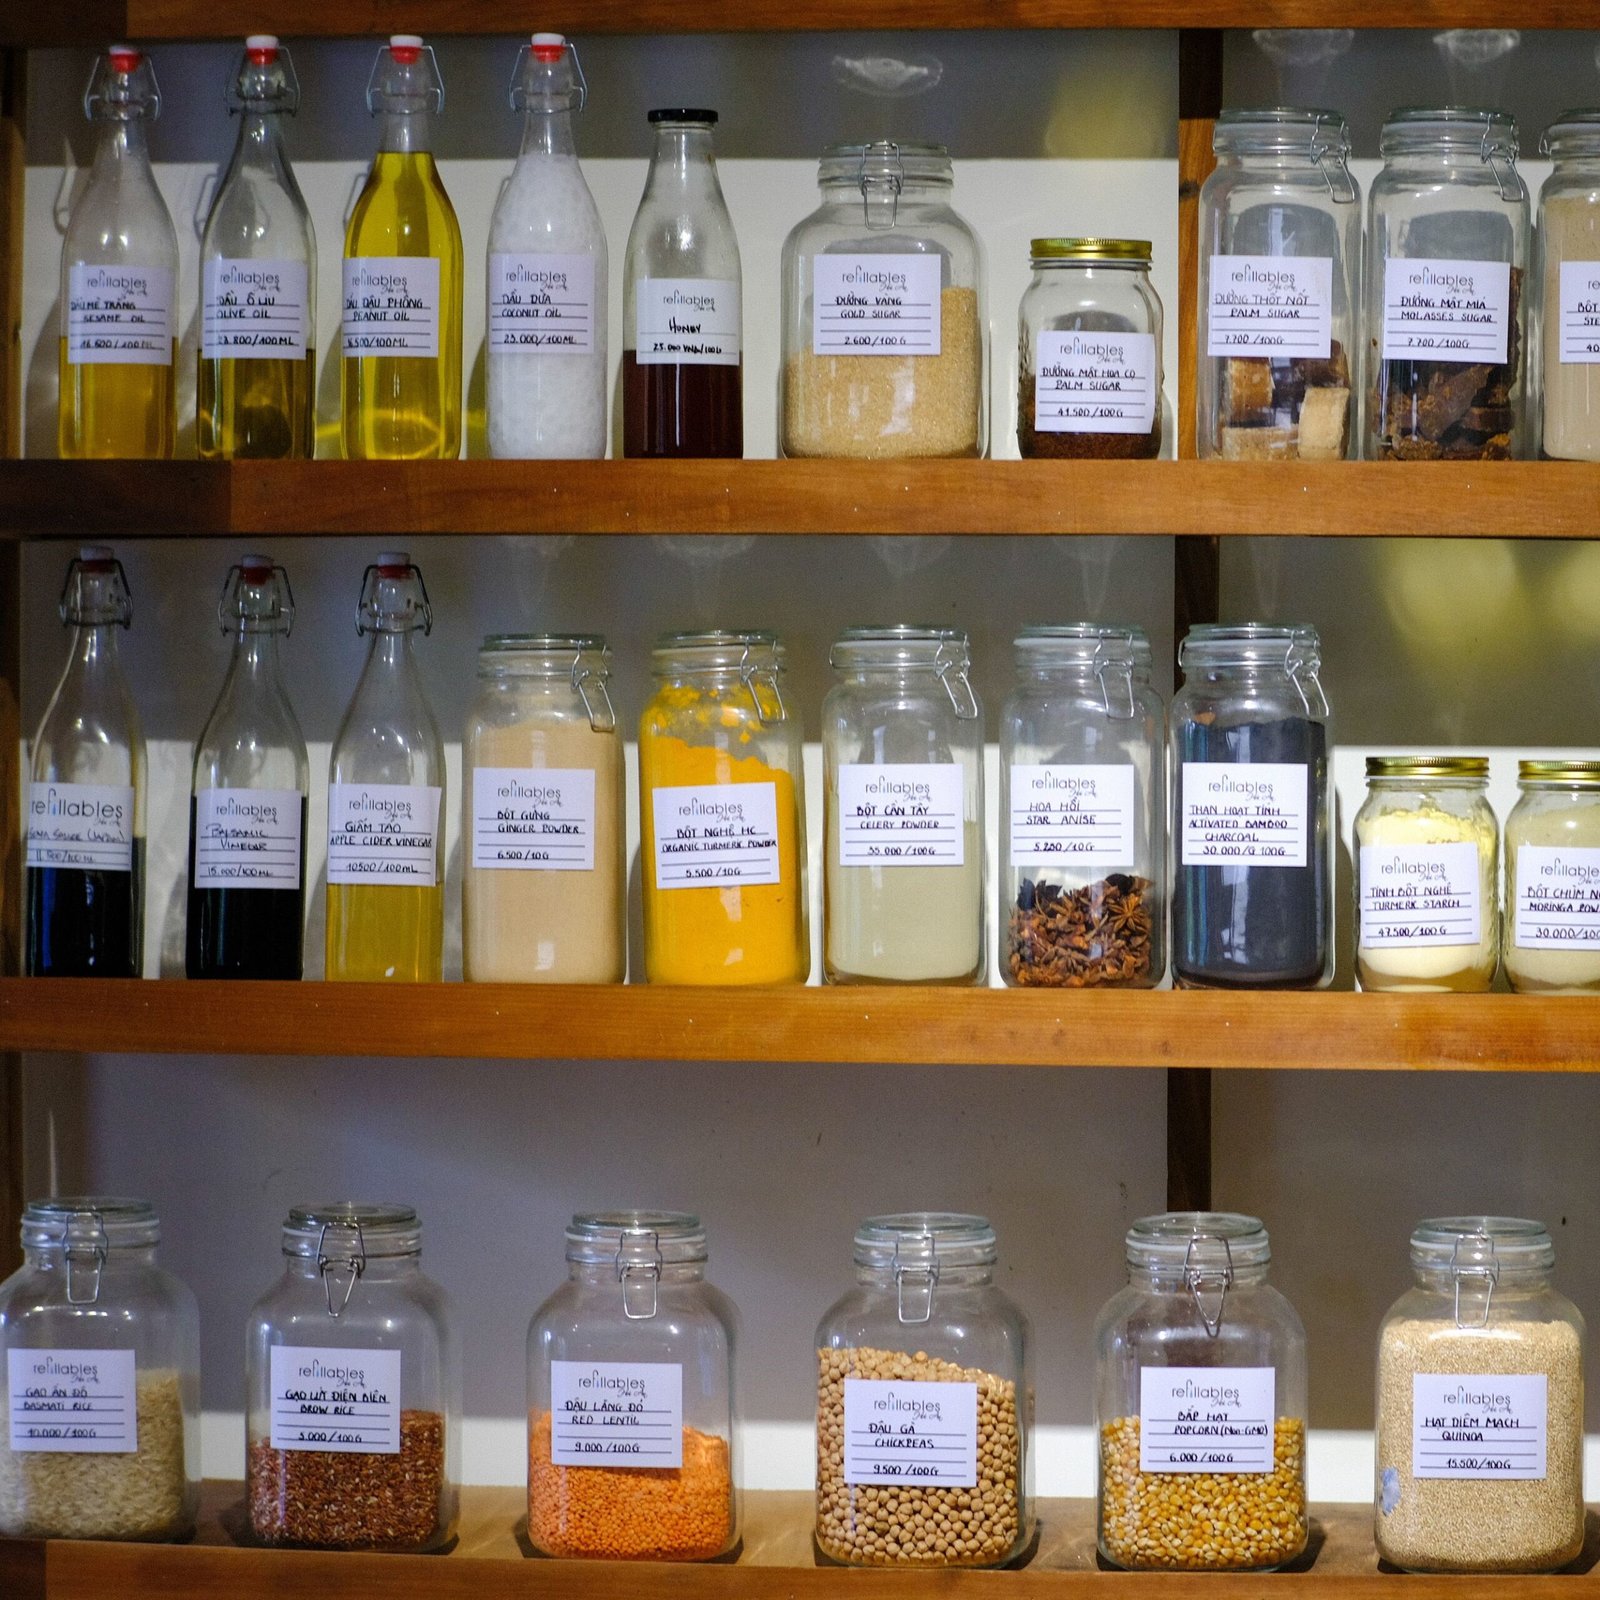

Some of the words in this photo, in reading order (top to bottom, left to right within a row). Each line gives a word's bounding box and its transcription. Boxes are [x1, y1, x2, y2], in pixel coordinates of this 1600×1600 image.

[87, 270, 147, 288] refillables
[220, 265, 279, 283] refillables
[352, 268, 407, 286] refillables
[506, 264, 566, 282] refillables
[842, 265, 906, 284] refillables
[1232, 264, 1295, 282] refillables
[1410, 267, 1473, 286] refillables
[663, 289, 715, 304] refillables
[131, 314, 145, 323] OIL
[253, 307, 271, 318] OIL
[353, 311, 388, 321] PEANUT
[394, 311, 409, 321] OIL
[502, 308, 539, 317] COCONUT
[545, 307, 561, 317] OIL
[841, 309, 865, 319] GOLD
[872, 309, 901, 319] SUGAR
[1230, 308, 1260, 318] PALM
[1268, 308, 1300, 318] SUGAR
[1401, 311, 1454, 321] MOLASSES
[1462, 313, 1492, 323] SUGAR
[1060, 337, 1124, 355] refillables
[1055, 380, 1083, 390] PALM
[1090, 381, 1121, 391] SUGAR
[866, 775, 930, 795] refillables
[1032, 771, 1096, 790] refillables
[1209, 774, 1273, 794] refillables
[498, 779, 560, 799] refillables
[32, 788, 123, 818] refillables
[216, 797, 277, 816] refillables
[349, 792, 411, 811] refillables
[679, 797, 743, 815] refillables
[1030, 802, 1051, 812] HOA
[1191, 805, 1217, 815] THAN
[860, 821, 895, 829] CELERY
[901, 821, 939, 829] POWDER
[1026, 816, 1050, 825] STAR
[1061, 814, 1096, 825] ANISE
[1189, 820, 1238, 828] ACTIVATED
[498, 823, 535, 833] GINGER
[542, 824, 579, 834] POWDER
[741, 826, 756, 835] HC
[330, 835, 355, 845] APPLE
[363, 836, 392, 846] CIDER
[396, 835, 432, 848] VINEGAR
[1205, 833, 1259, 842] CHARCOAL
[662, 842, 699, 853] ORGANIC
[748, 839, 777, 848] POWDER
[1382, 856, 1445, 875] refillables
[1423, 899, 1460, 909] STARCH
[1529, 901, 1573, 912] MORINGA
[34, 1356, 98, 1375] refillables
[299, 1359, 364, 1379] refillables
[579, 1370, 645, 1389] refillables
[1172, 1379, 1239, 1400] refillables
[1443, 1385, 1511, 1406] refillables
[24, 1402, 65, 1410] BASMATI
[73, 1402, 94, 1411] RICE
[874, 1392, 940, 1412] refillables
[334, 1406, 355, 1415] RICE
[572, 1415, 593, 1425] RED
[603, 1415, 639, 1425] LENTIL
[1442, 1430, 1483, 1442] QUINOA
[875, 1438, 935, 1449] CHICKPEAS
